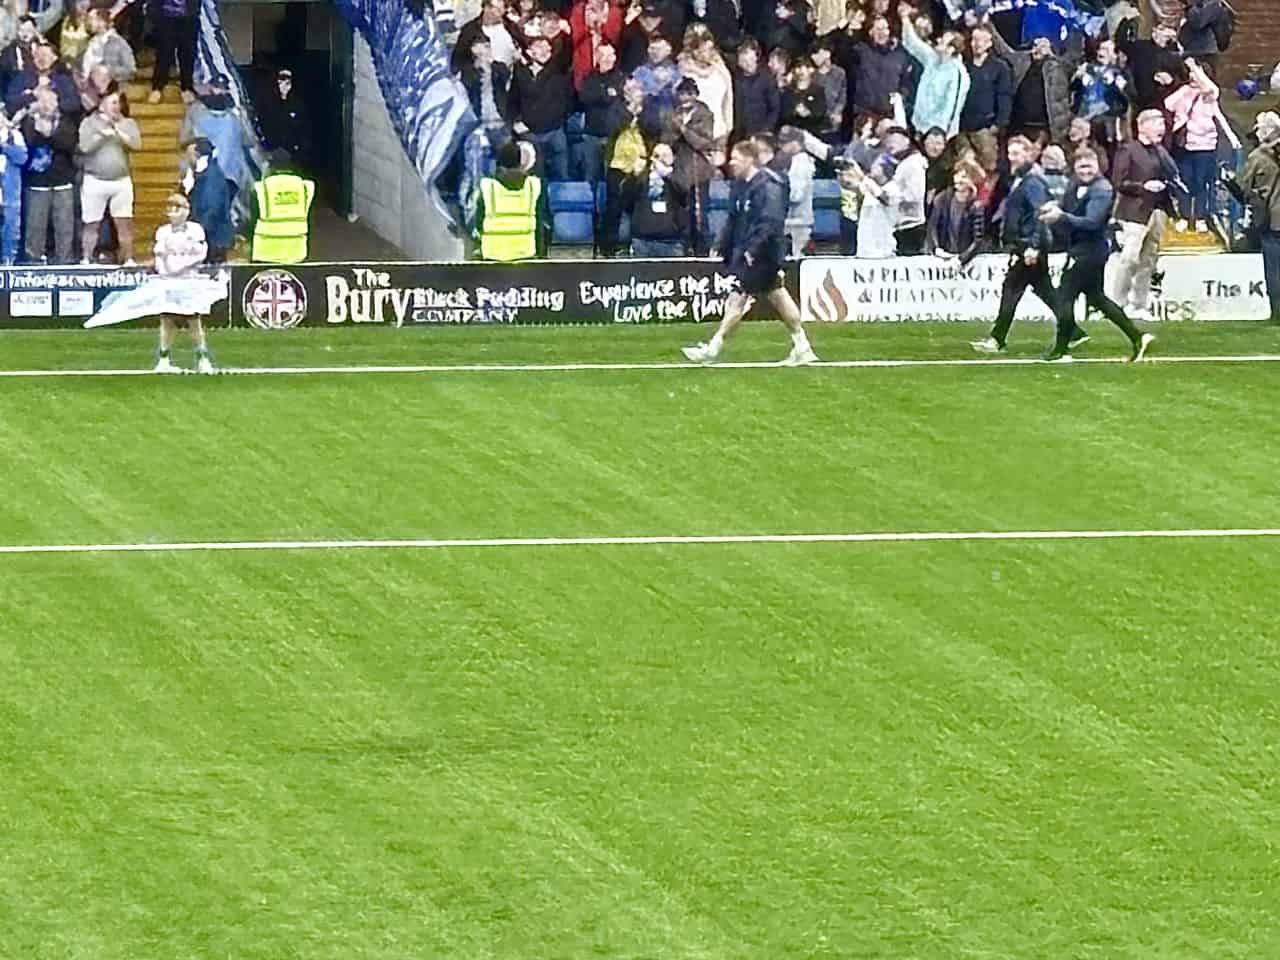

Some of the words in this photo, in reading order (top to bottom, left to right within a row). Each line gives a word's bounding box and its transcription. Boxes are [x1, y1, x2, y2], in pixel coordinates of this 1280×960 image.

[352, 268, 392, 287] The
[1202, 279, 1242, 298] The
[325, 275, 416, 329] Bury
